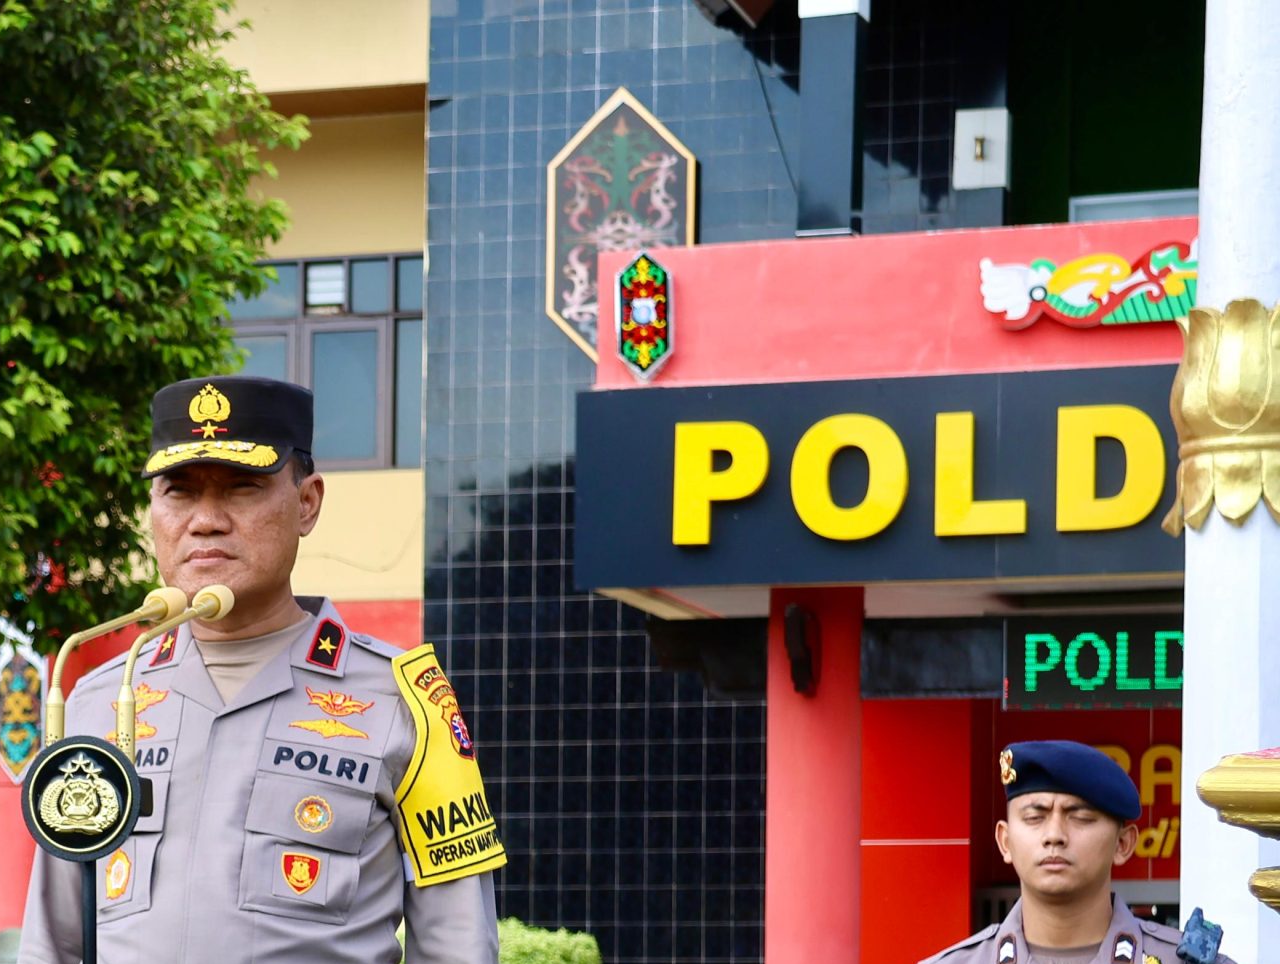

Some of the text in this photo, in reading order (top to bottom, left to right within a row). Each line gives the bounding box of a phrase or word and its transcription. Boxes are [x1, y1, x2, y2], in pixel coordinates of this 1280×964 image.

[672, 404, 1166, 547] POLD
[1024, 630, 1184, 692] POLD
[273, 746, 369, 784] POLRI
[416, 791, 491, 840] WAKIL
[428, 836, 478, 867] OPERASI
